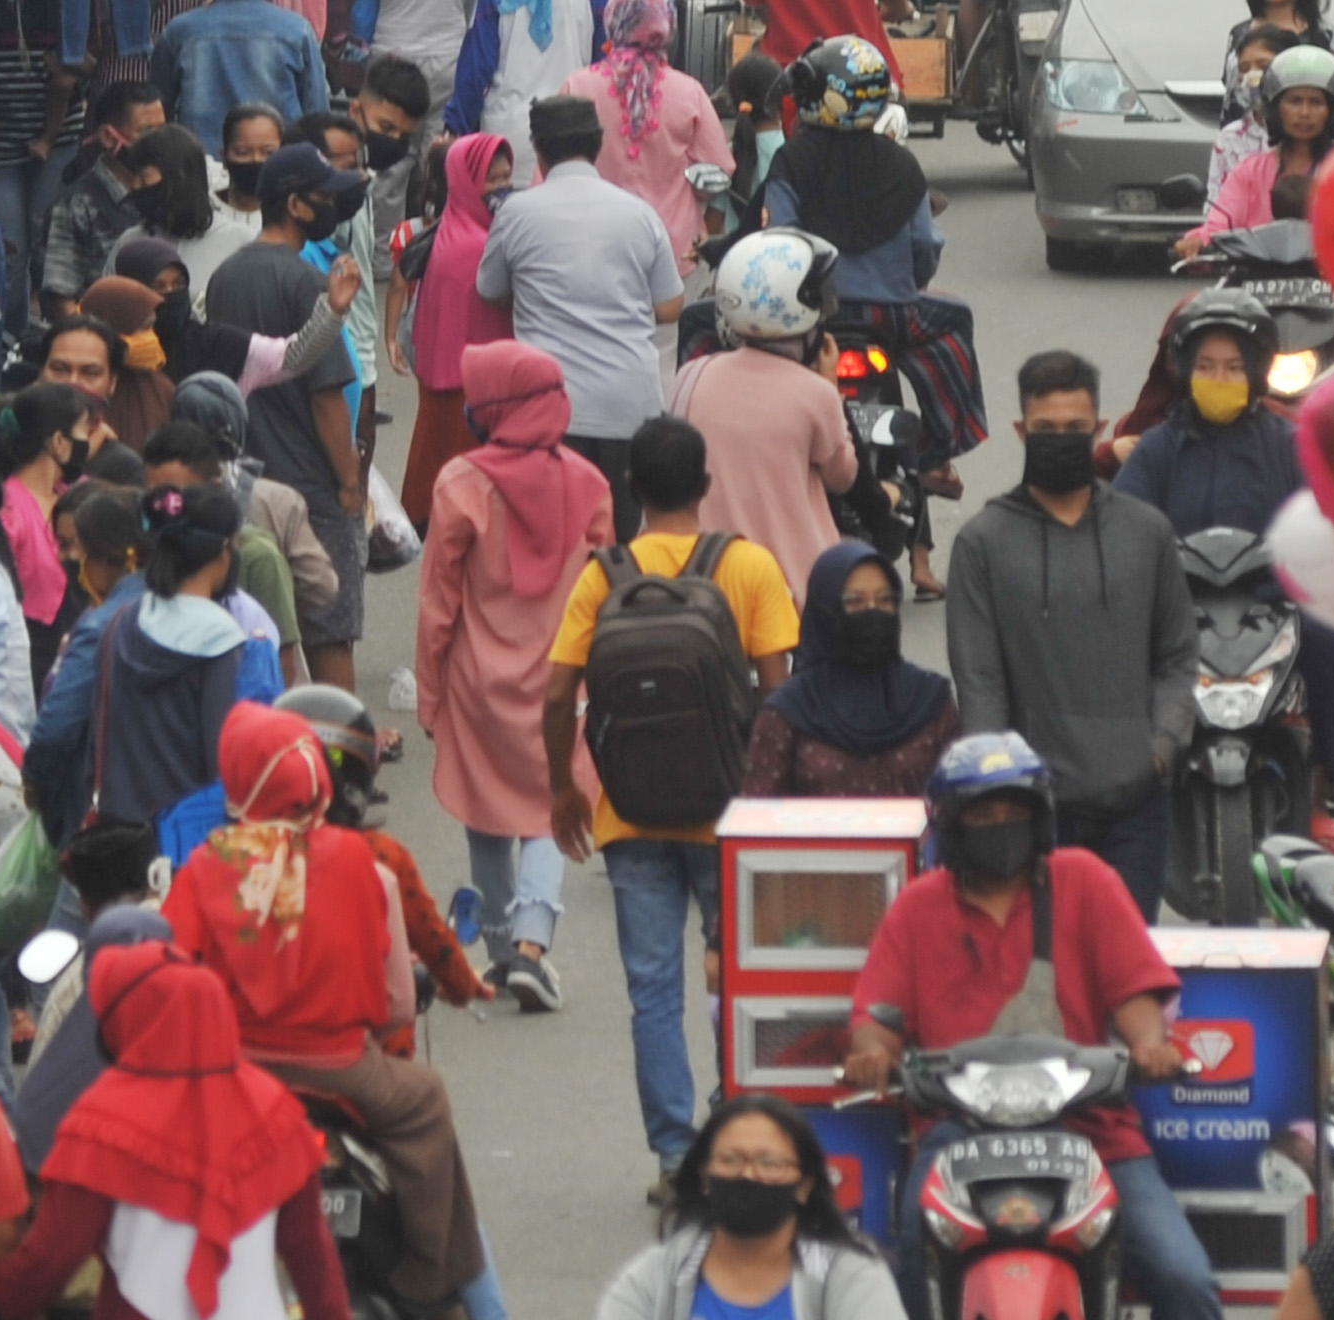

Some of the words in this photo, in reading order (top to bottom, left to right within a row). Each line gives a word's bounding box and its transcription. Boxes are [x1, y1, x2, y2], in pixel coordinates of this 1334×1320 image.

[1174, 1086, 1250, 1104] Diamond
[1156, 1118, 1188, 1140] ice
[1195, 1119, 1270, 1140] cream
